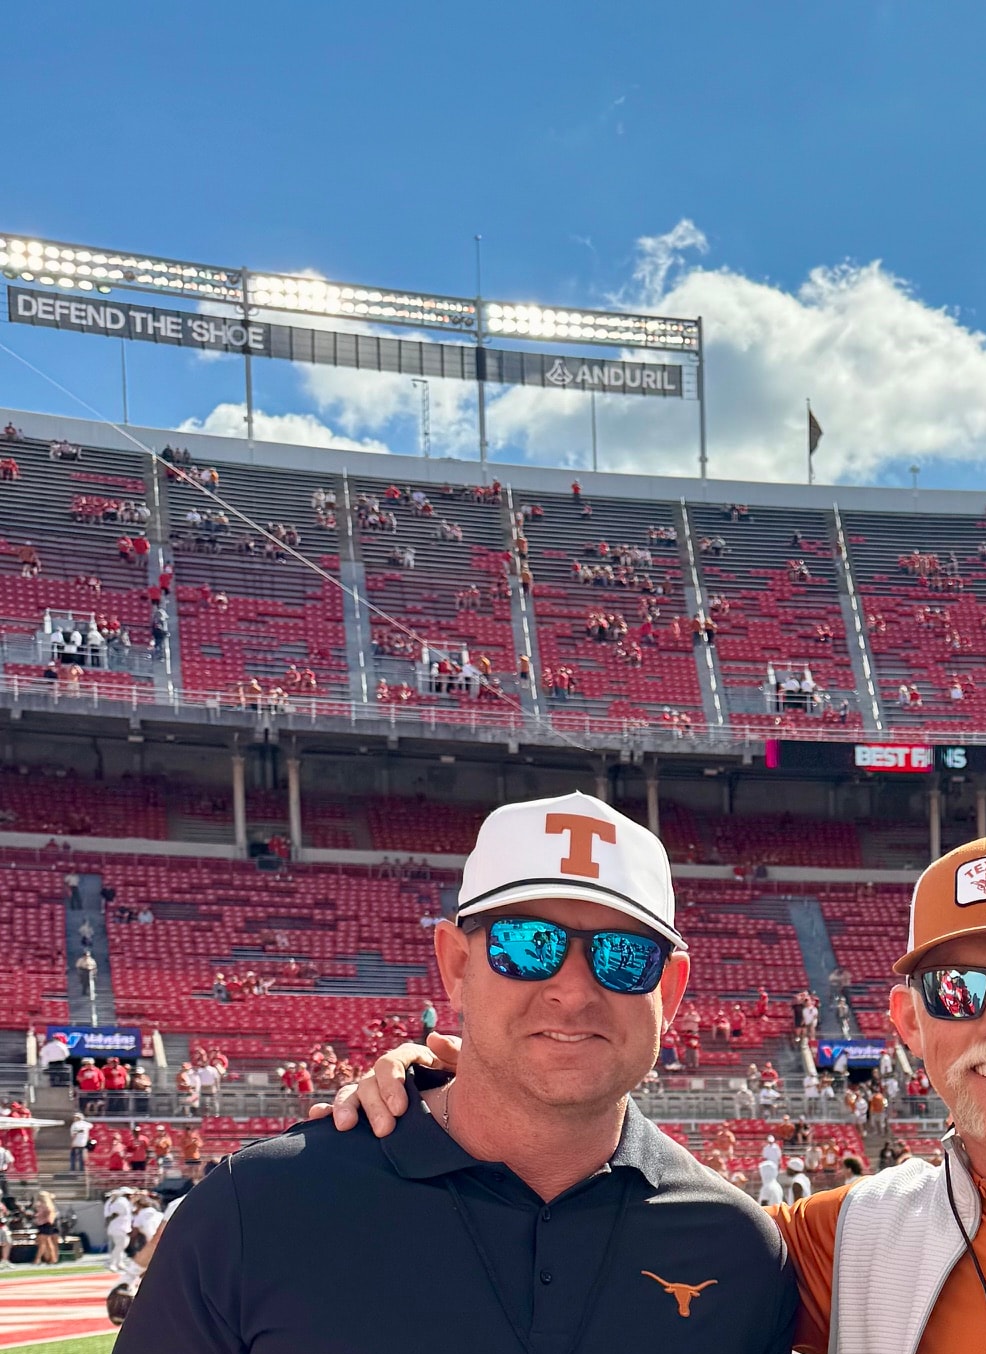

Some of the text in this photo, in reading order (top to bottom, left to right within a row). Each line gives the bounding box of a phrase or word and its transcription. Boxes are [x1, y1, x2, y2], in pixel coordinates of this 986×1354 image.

[17, 294, 265, 349] DEFEND THE 'SHOE
[575, 364, 676, 390] ANDURIL
[855, 745, 908, 767] BEST
[545, 812, 616, 879] T
